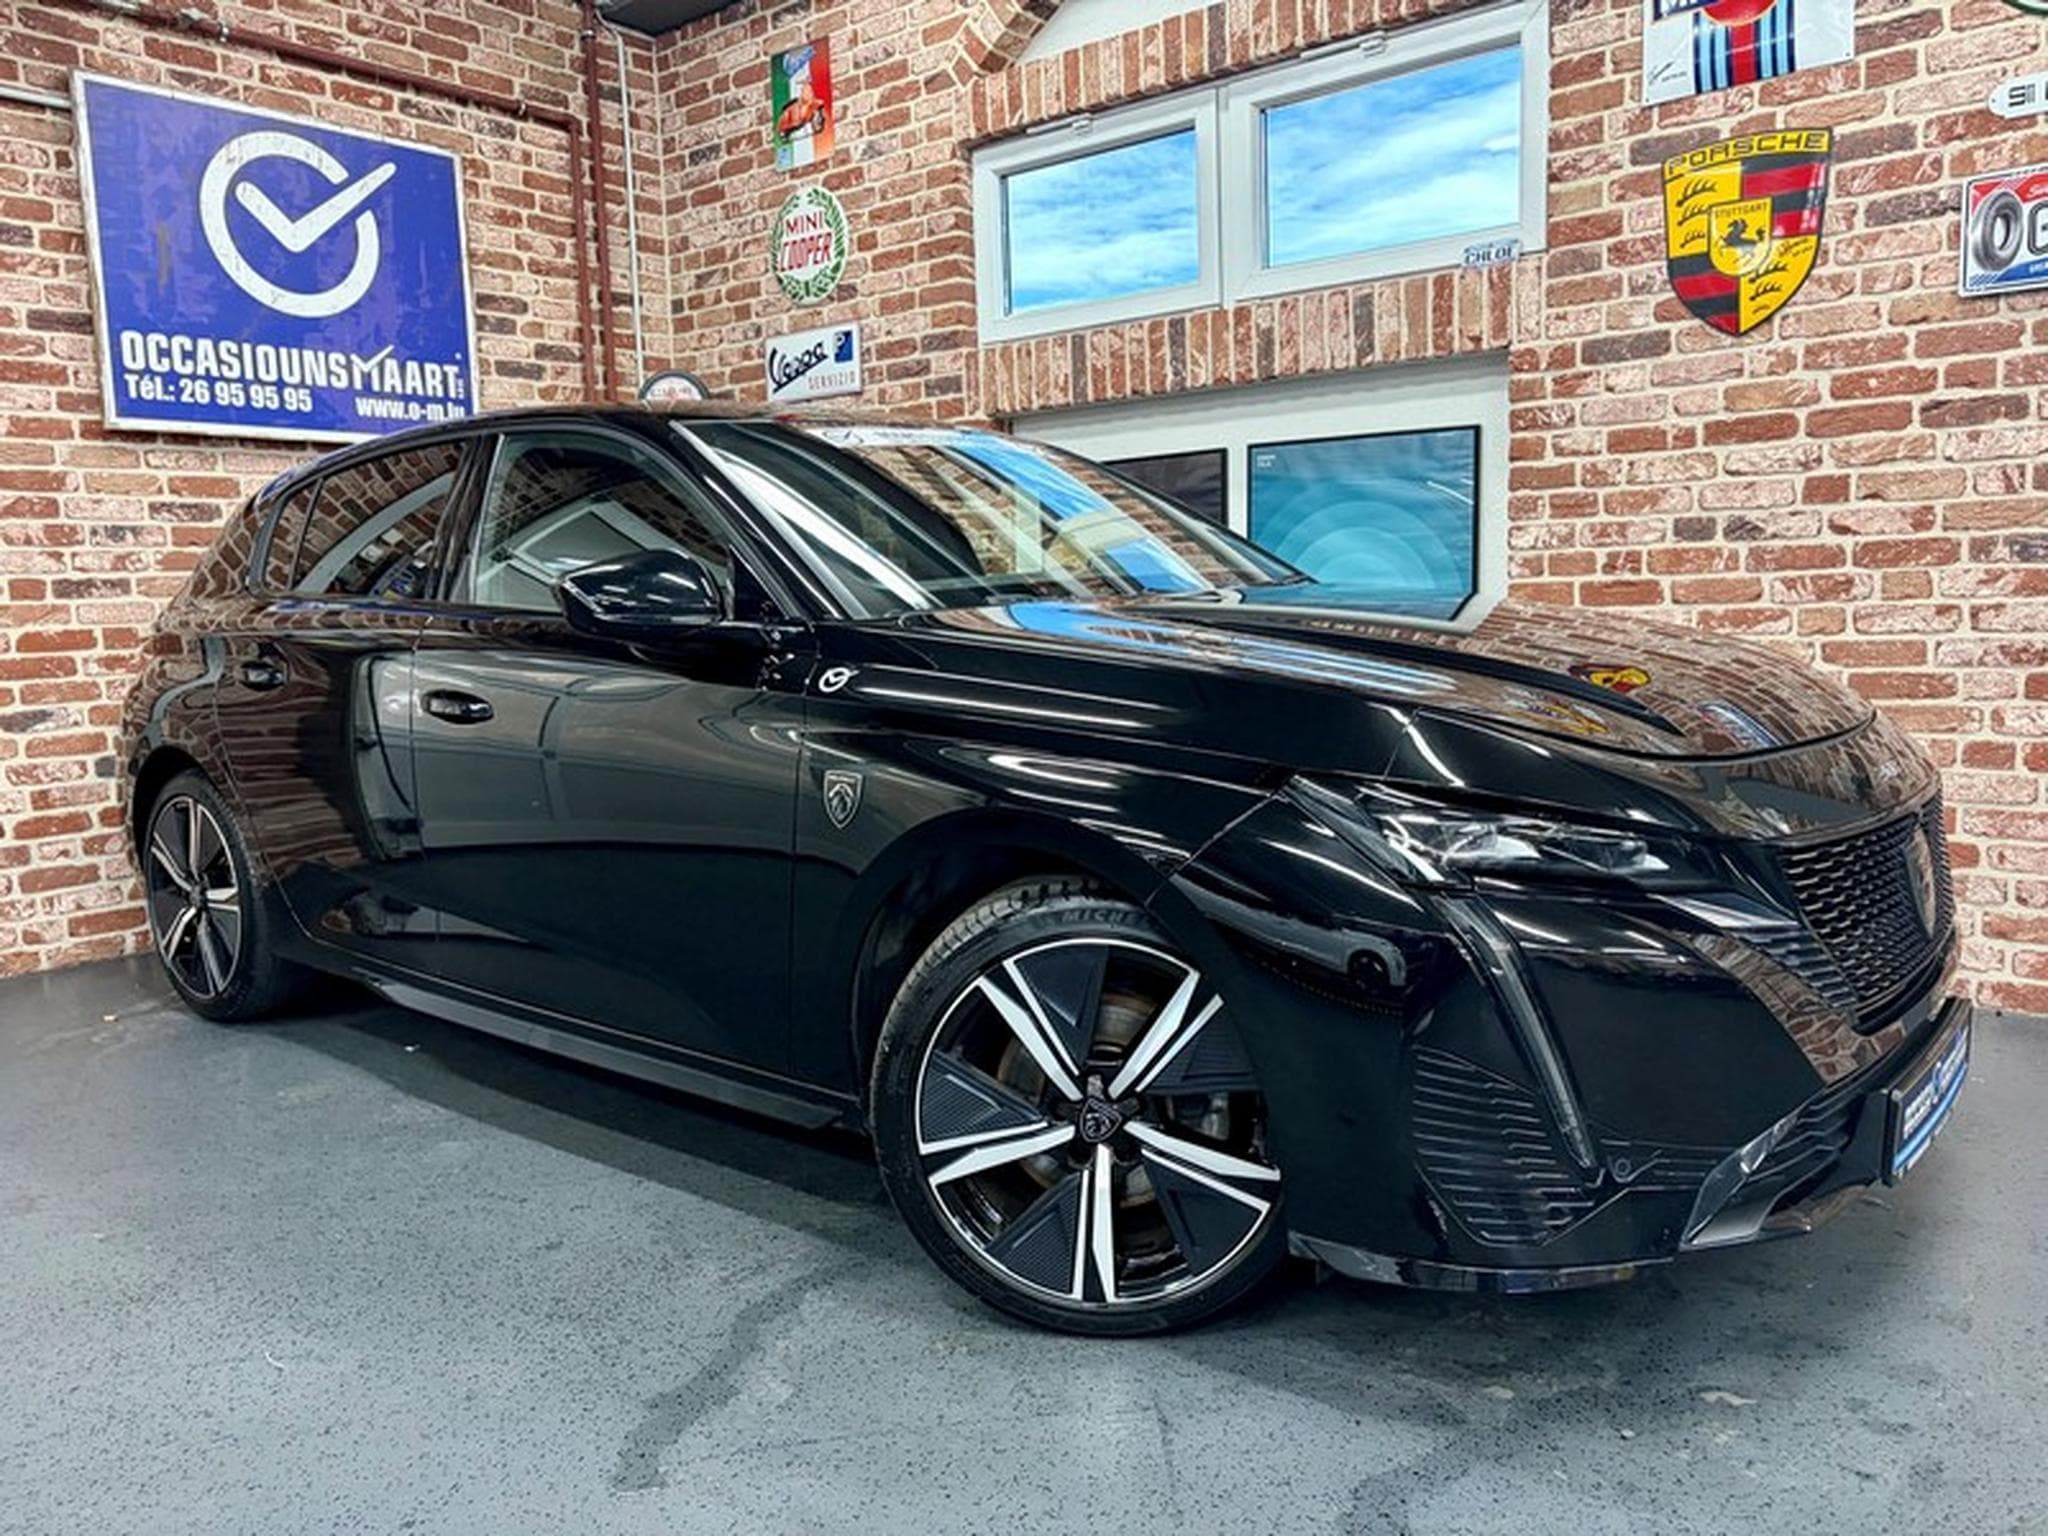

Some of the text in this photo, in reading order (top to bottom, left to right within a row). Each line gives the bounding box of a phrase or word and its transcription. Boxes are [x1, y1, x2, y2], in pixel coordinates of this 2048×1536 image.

[1668, 133, 1825, 174] PORSCHE
[786, 211, 823, 237] MINI
[780, 233, 832, 271] COOPER
[120, 330, 459, 399] OCCASIOUNSMAART
[769, 341, 828, 394] Vespa
[808, 371, 855, 389] SERVIZIO
[179, 378, 211, 405] 26
[214, 381, 246, 407] 95
[250, 384, 280, 410] 95
[284, 387, 313, 412] 95
[355, 397, 465, 421] www.o-m.lu
